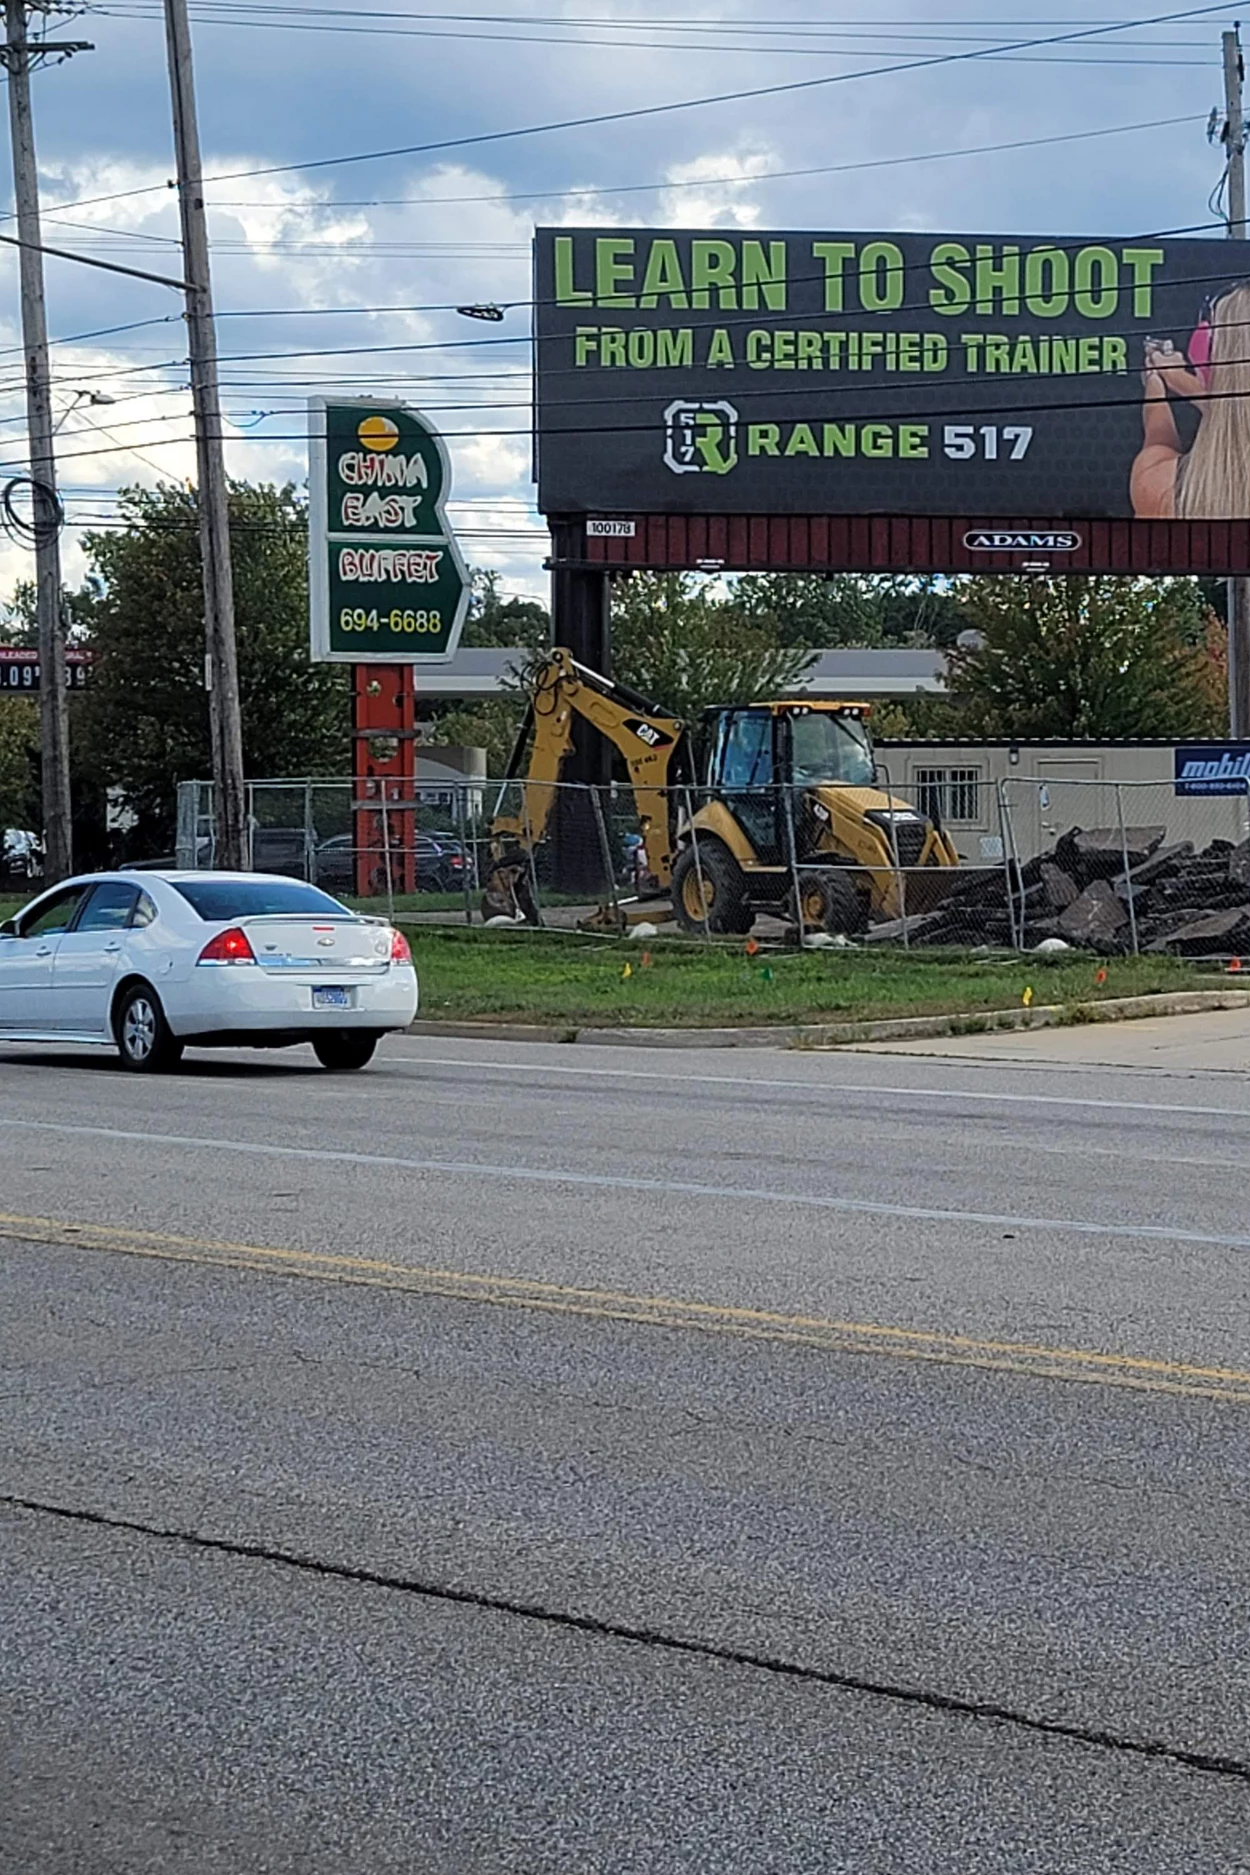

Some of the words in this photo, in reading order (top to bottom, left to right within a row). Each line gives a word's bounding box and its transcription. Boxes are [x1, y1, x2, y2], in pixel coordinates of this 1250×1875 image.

[554, 236, 787, 311] LEARN
[812, 241, 906, 315] TO
[928, 243, 1165, 319] SHOOT
[575, 326, 693, 369] FROM
[707, 329, 734, 369] A
[747, 330, 948, 373] CERTIFIED
[961, 333, 1128, 376] TRAINER
[747, 423, 929, 459] RANGE
[943, 425, 1034, 461] 517
[339, 452, 428, 489] CHINA
[341, 492, 422, 527] EAST
[972, 535, 1073, 547] ADAMS
[339, 548, 443, 582] BUFFET
[340, 608, 441, 633] 694-6688
[636, 723, 660, 745] CAT
